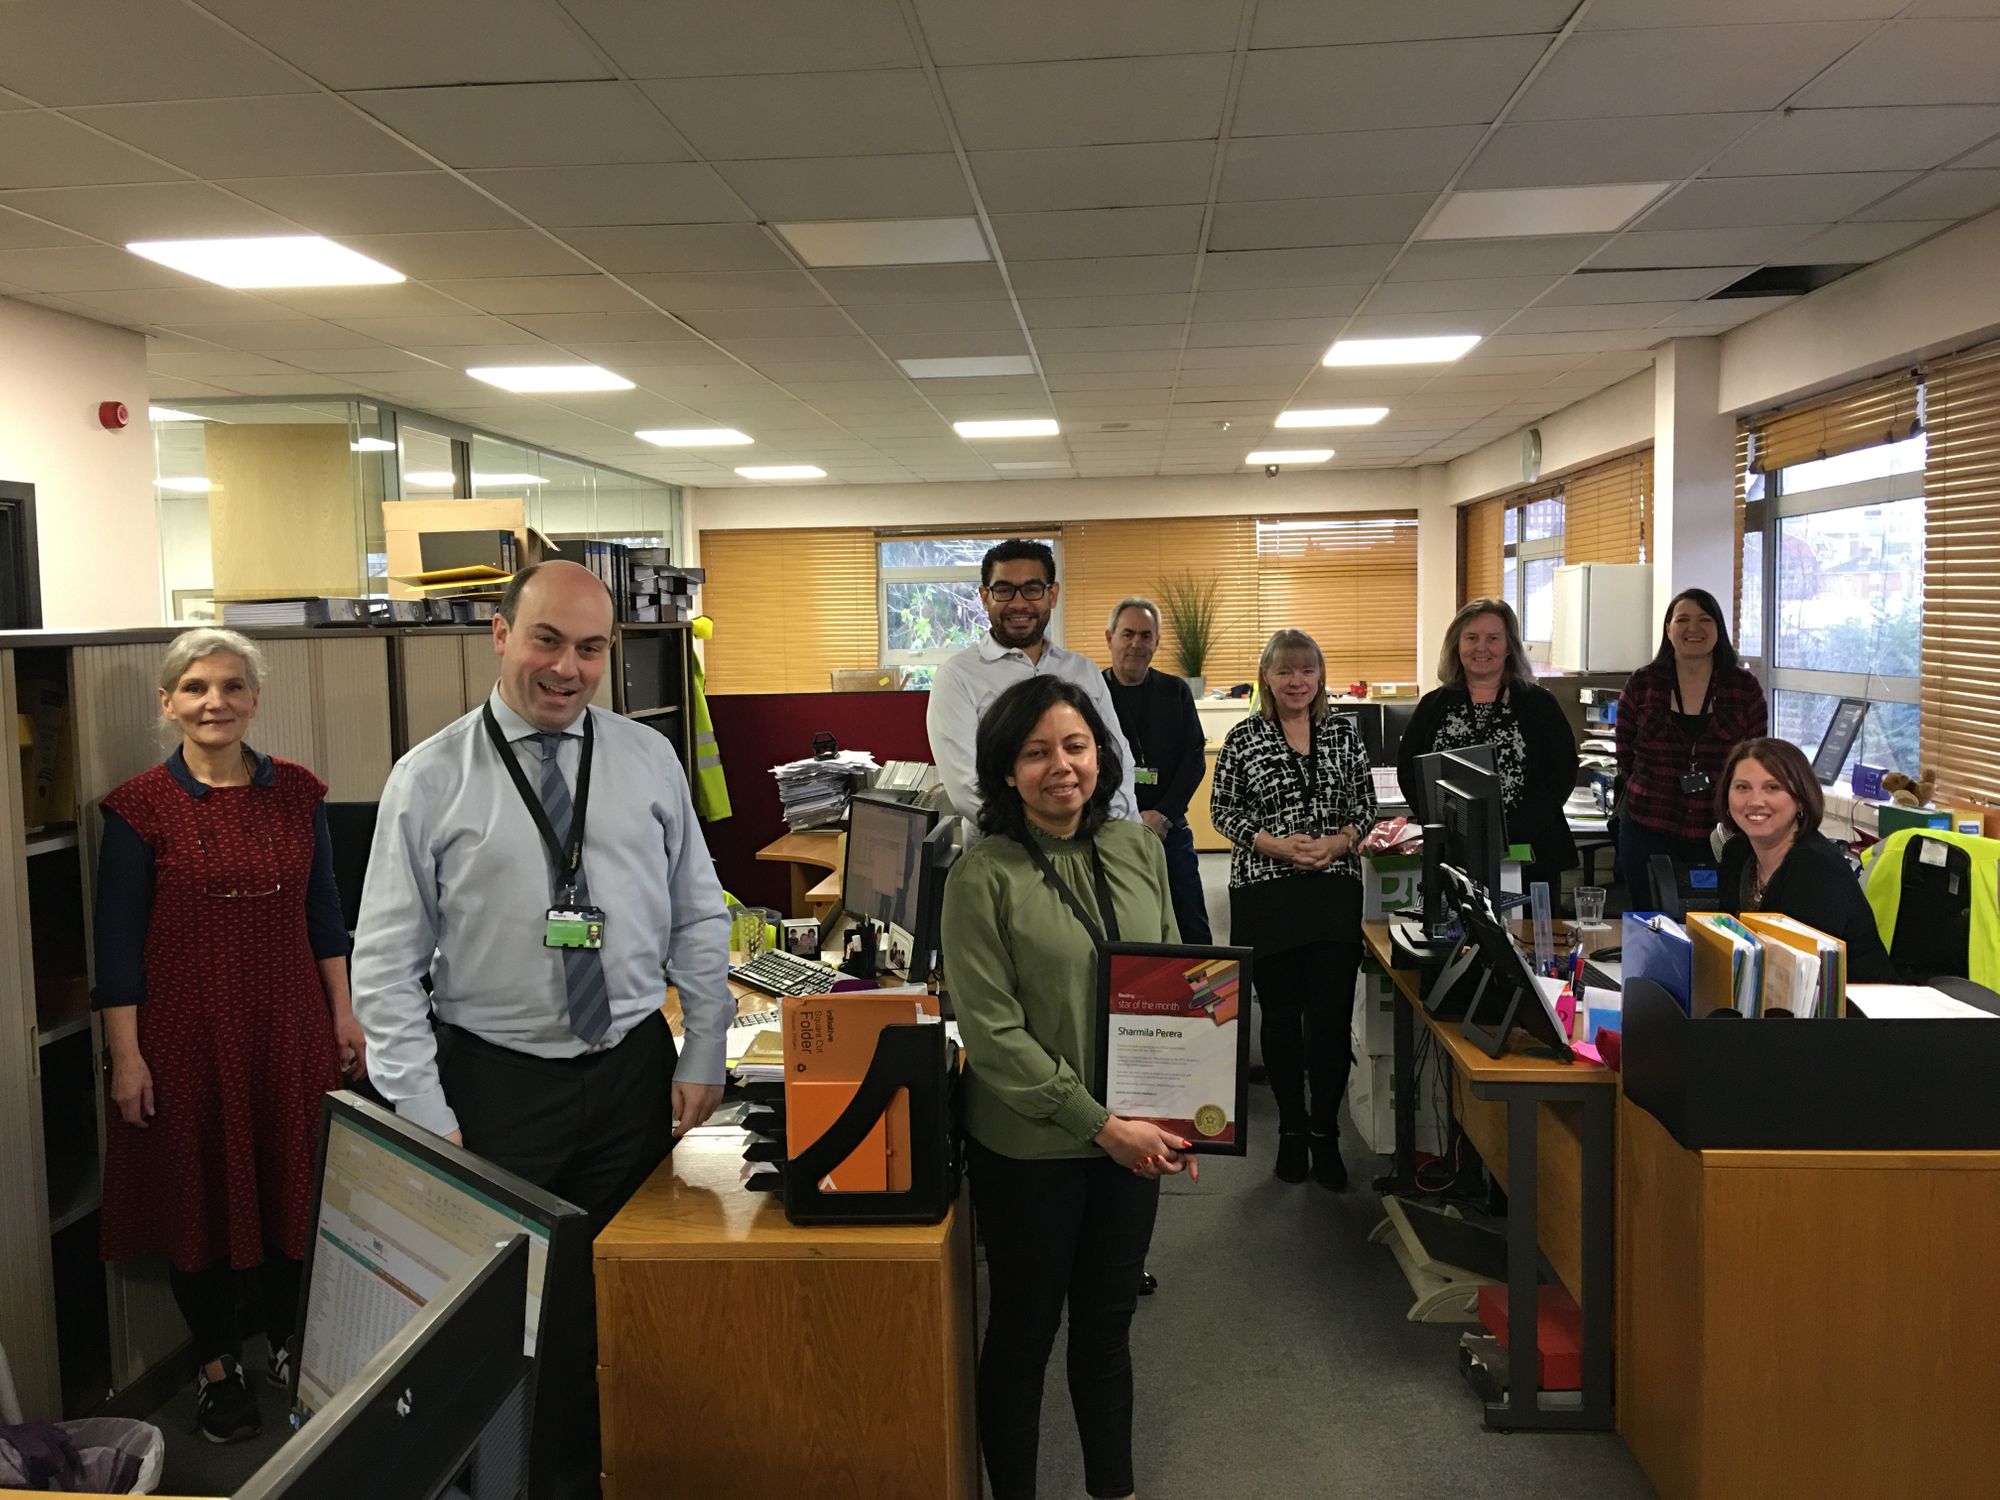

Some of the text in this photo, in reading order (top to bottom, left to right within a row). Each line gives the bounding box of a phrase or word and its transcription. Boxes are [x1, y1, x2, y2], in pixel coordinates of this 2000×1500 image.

[1118, 1000, 1180, 1011] star of the month
[800, 1011, 814, 1054] Folder
[814, 1010, 822, 1037] Square
[1117, 1026, 1183, 1039] Sharmila Perera
